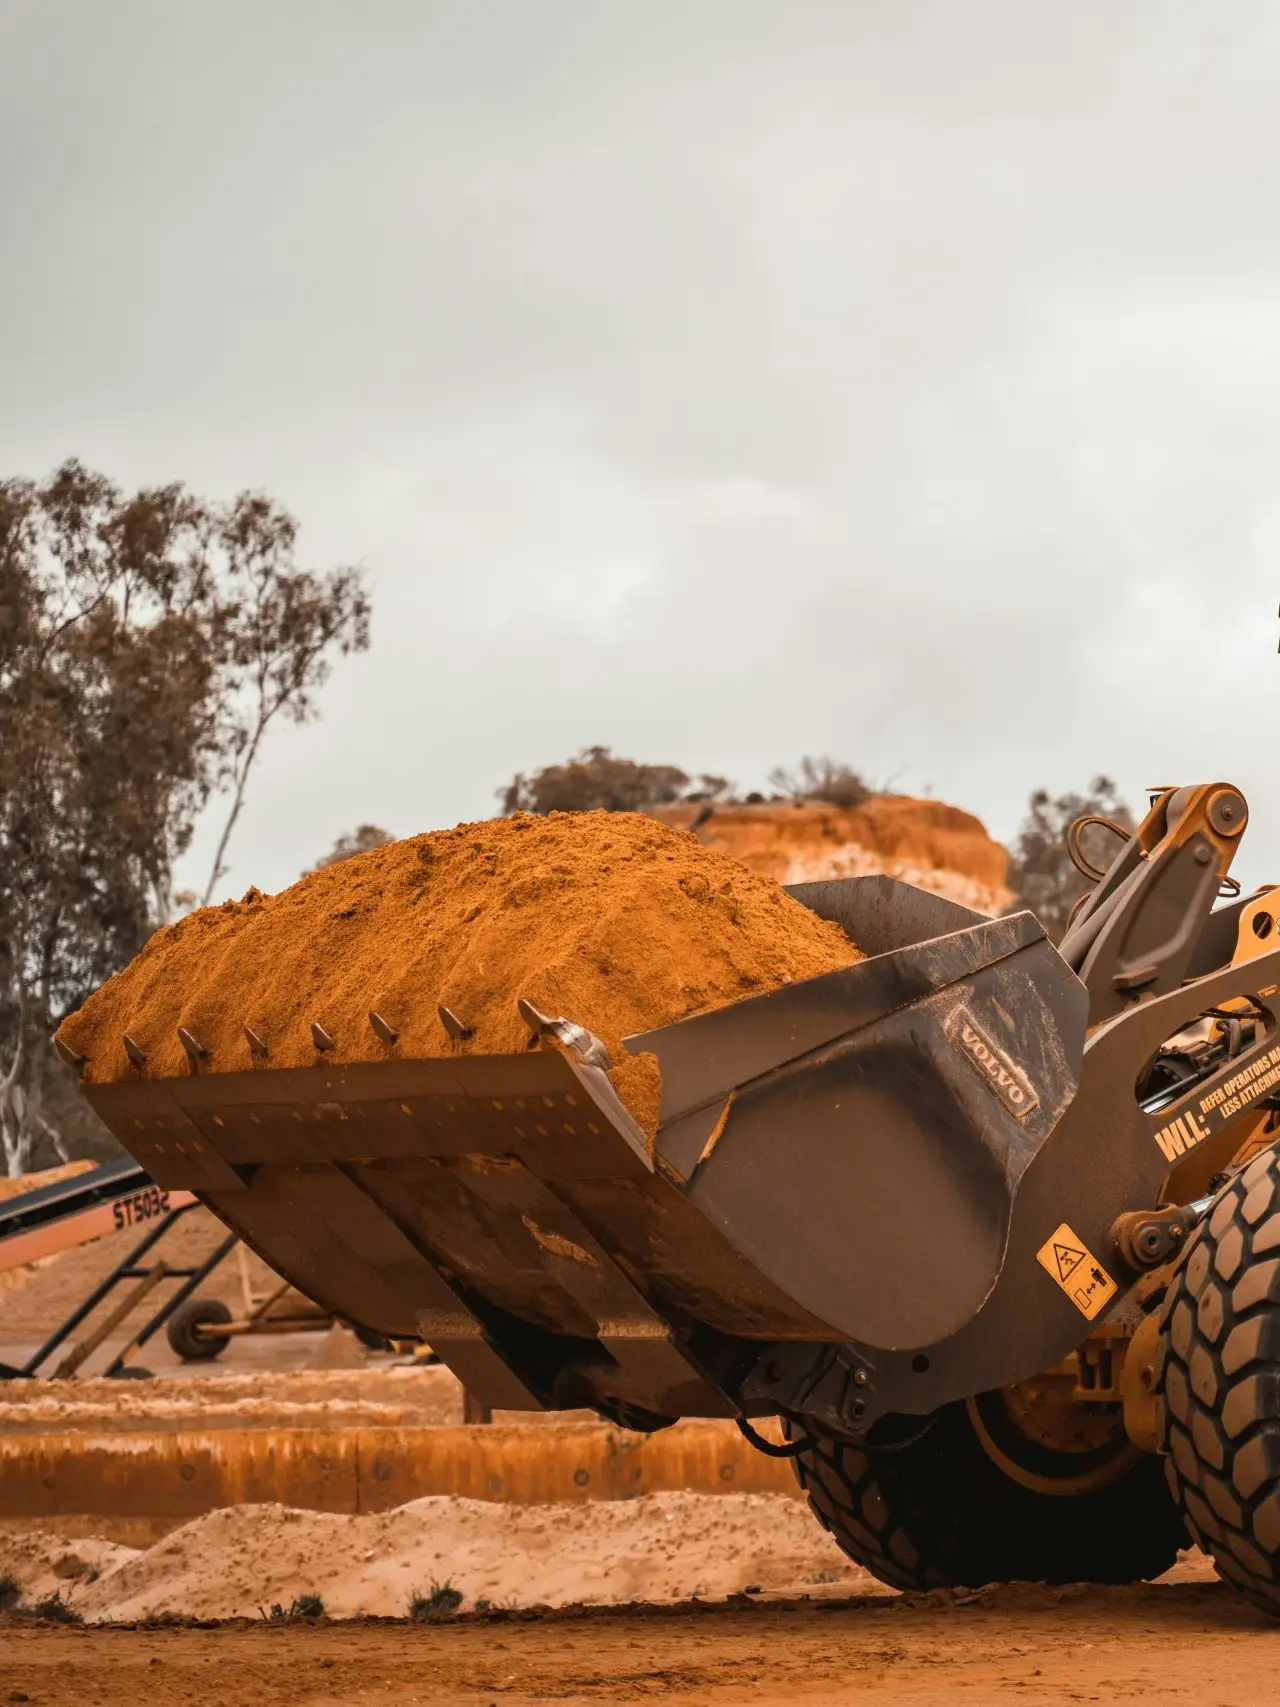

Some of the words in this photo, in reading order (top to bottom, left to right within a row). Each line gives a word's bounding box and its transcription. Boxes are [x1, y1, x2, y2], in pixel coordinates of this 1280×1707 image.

[962, 1024, 1024, 1103] VOLVO
[1200, 1083, 1227, 1115] REFER
[1223, 1055, 1273, 1096] OPERATORS
[1219, 1095, 1243, 1119] LESS
[1154, 1111, 1212, 1163] WLL:
